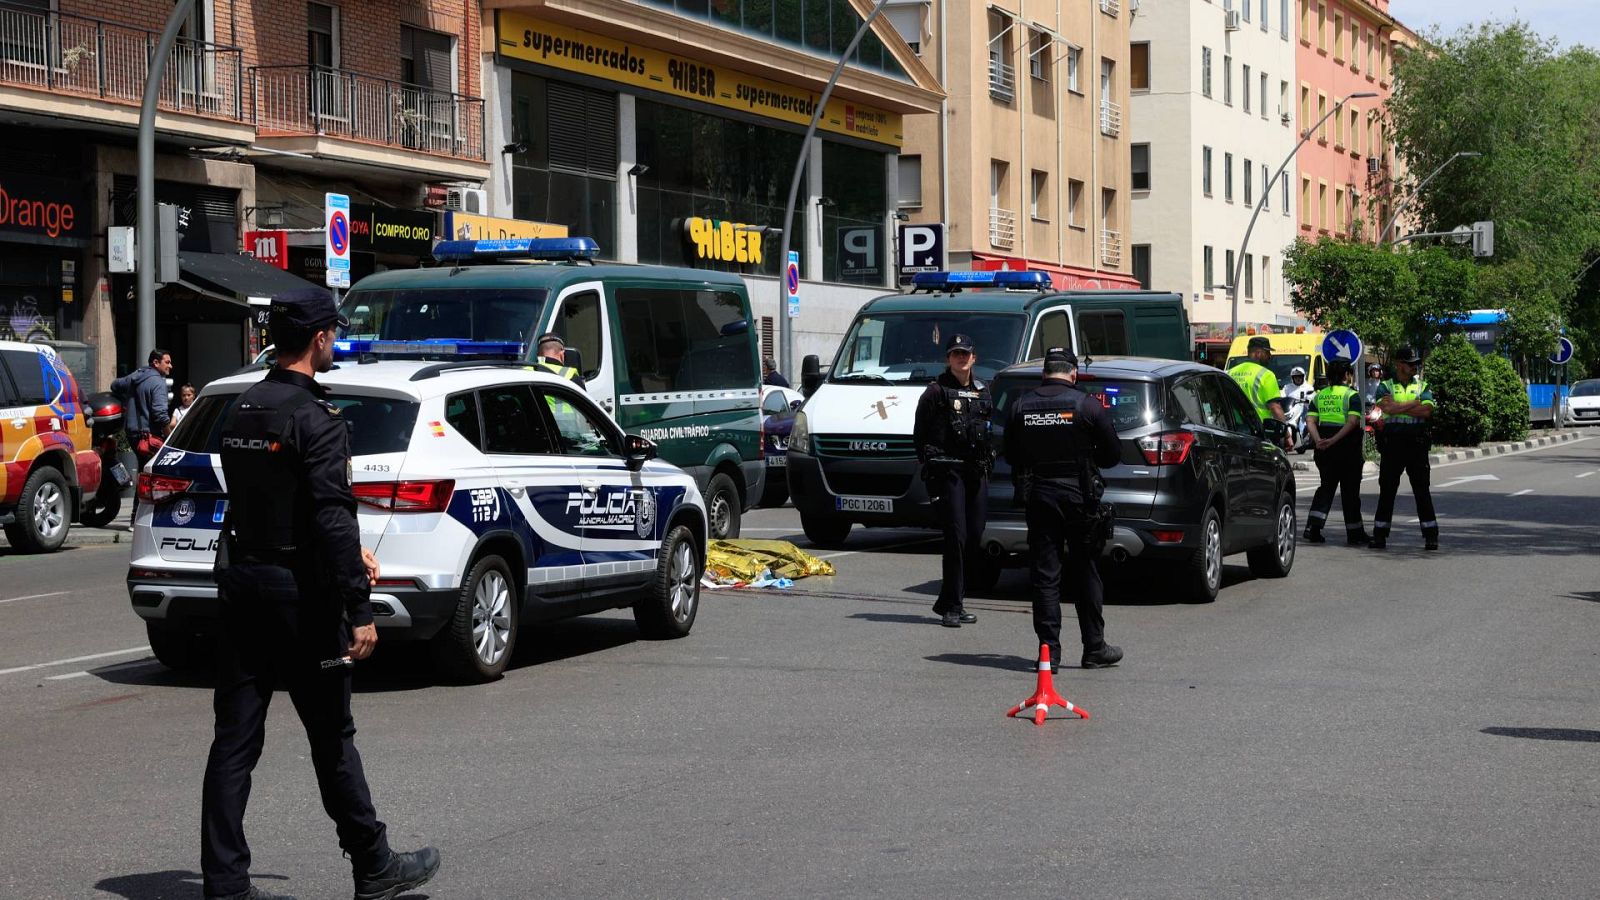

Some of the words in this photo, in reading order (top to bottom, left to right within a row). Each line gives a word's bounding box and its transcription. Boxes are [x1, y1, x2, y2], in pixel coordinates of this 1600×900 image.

[522, 28, 645, 75] supermercados
[375, 222, 411, 239] COMPRO
[412, 226, 430, 240] ORO
[904, 227, 936, 266] P
[1024, 419, 1073, 427] NACIONAL
[640, 428, 669, 441] GUARDIA
[222, 437, 271, 452] POLICIA
[848, 440, 887, 451] IVECO
[363, 464, 390, 473] 4433
[842, 498, 860, 510] PGC
[862, 499, 885, 511] 1206
[472, 506, 491, 522] 112
